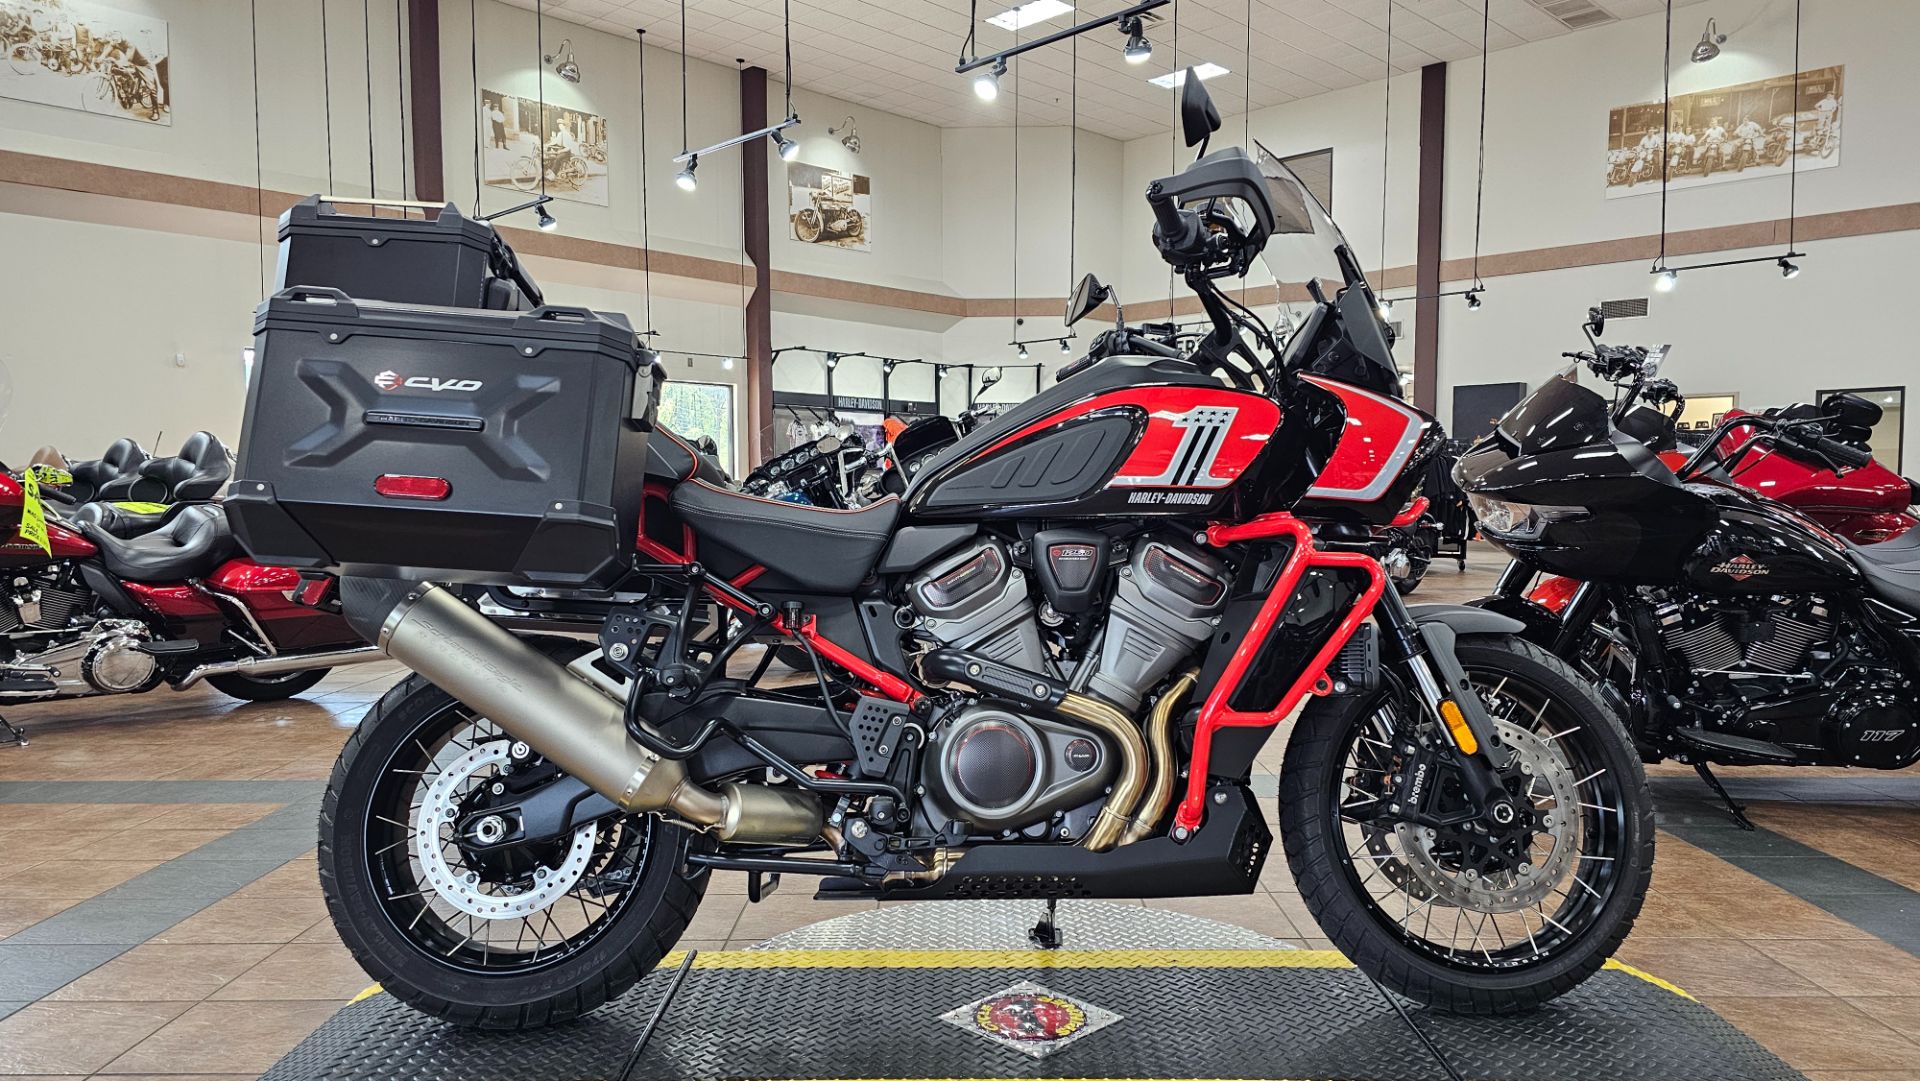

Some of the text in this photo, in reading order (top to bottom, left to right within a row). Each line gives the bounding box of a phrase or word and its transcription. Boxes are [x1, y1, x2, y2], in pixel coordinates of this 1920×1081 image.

[404, 376, 483, 391] CVO
[838, 396, 882, 409] HARLEY-DAVIDSON
[1128, 491, 1214, 505] HARLEY-DAVIDSON
[1710, 567, 1770, 575] DAVIDSON
[1860, 729, 1905, 741] 117
[1407, 763, 1427, 805] brembo
